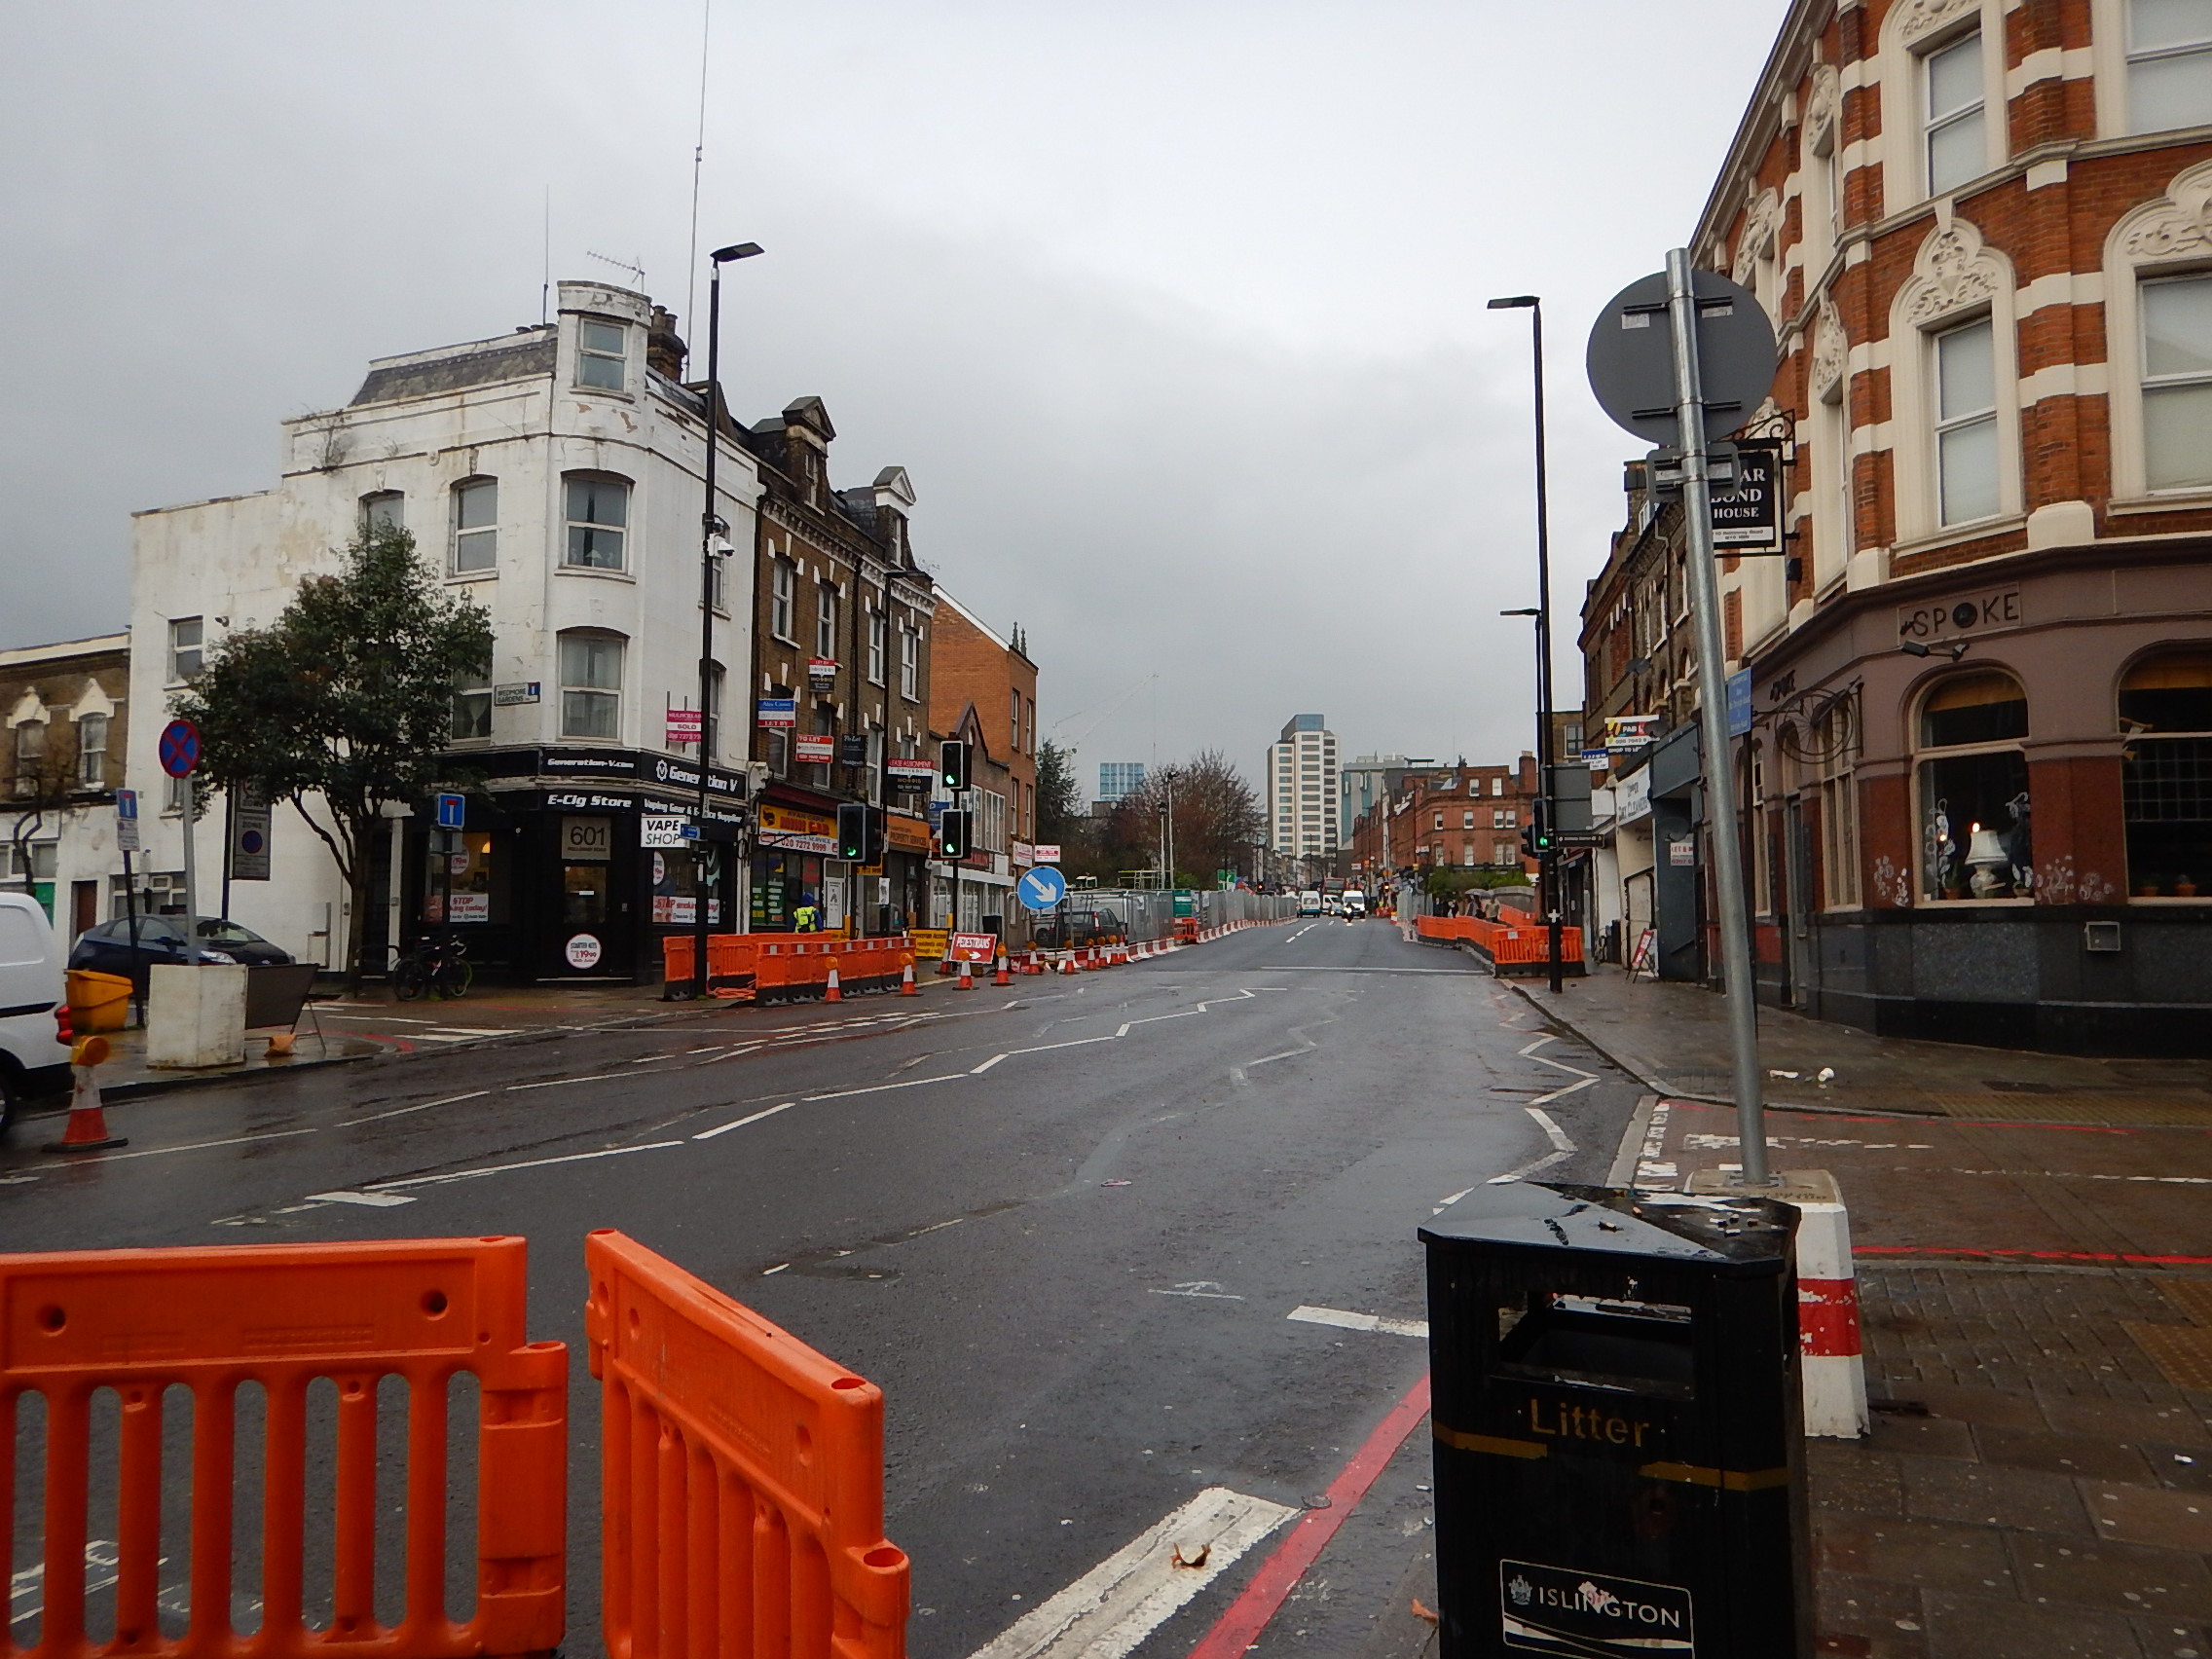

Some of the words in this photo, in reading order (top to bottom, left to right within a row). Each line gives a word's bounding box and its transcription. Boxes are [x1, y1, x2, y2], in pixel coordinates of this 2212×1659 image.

[1714, 507, 1759, 519] HOUSE
[547, 758, 634, 769] Generation-V.com
[669, 766, 728, 790] Genertion
[730, 778, 738, 792] V
[547, 794, 587, 808] E-Cig
[590, 795, 632, 808] Store
[647, 820, 679, 831] VAPE
[570, 826, 605, 846] 601
[645, 833, 681, 845] SHOP
[781, 838, 794, 848] 020
[796, 840, 811, 850] 7272
[956, 936, 991, 949] PEDESTRIANS
[1530, 1398, 1650, 1448] Litter
[1539, 1586, 1680, 1629] ISLINGTON
